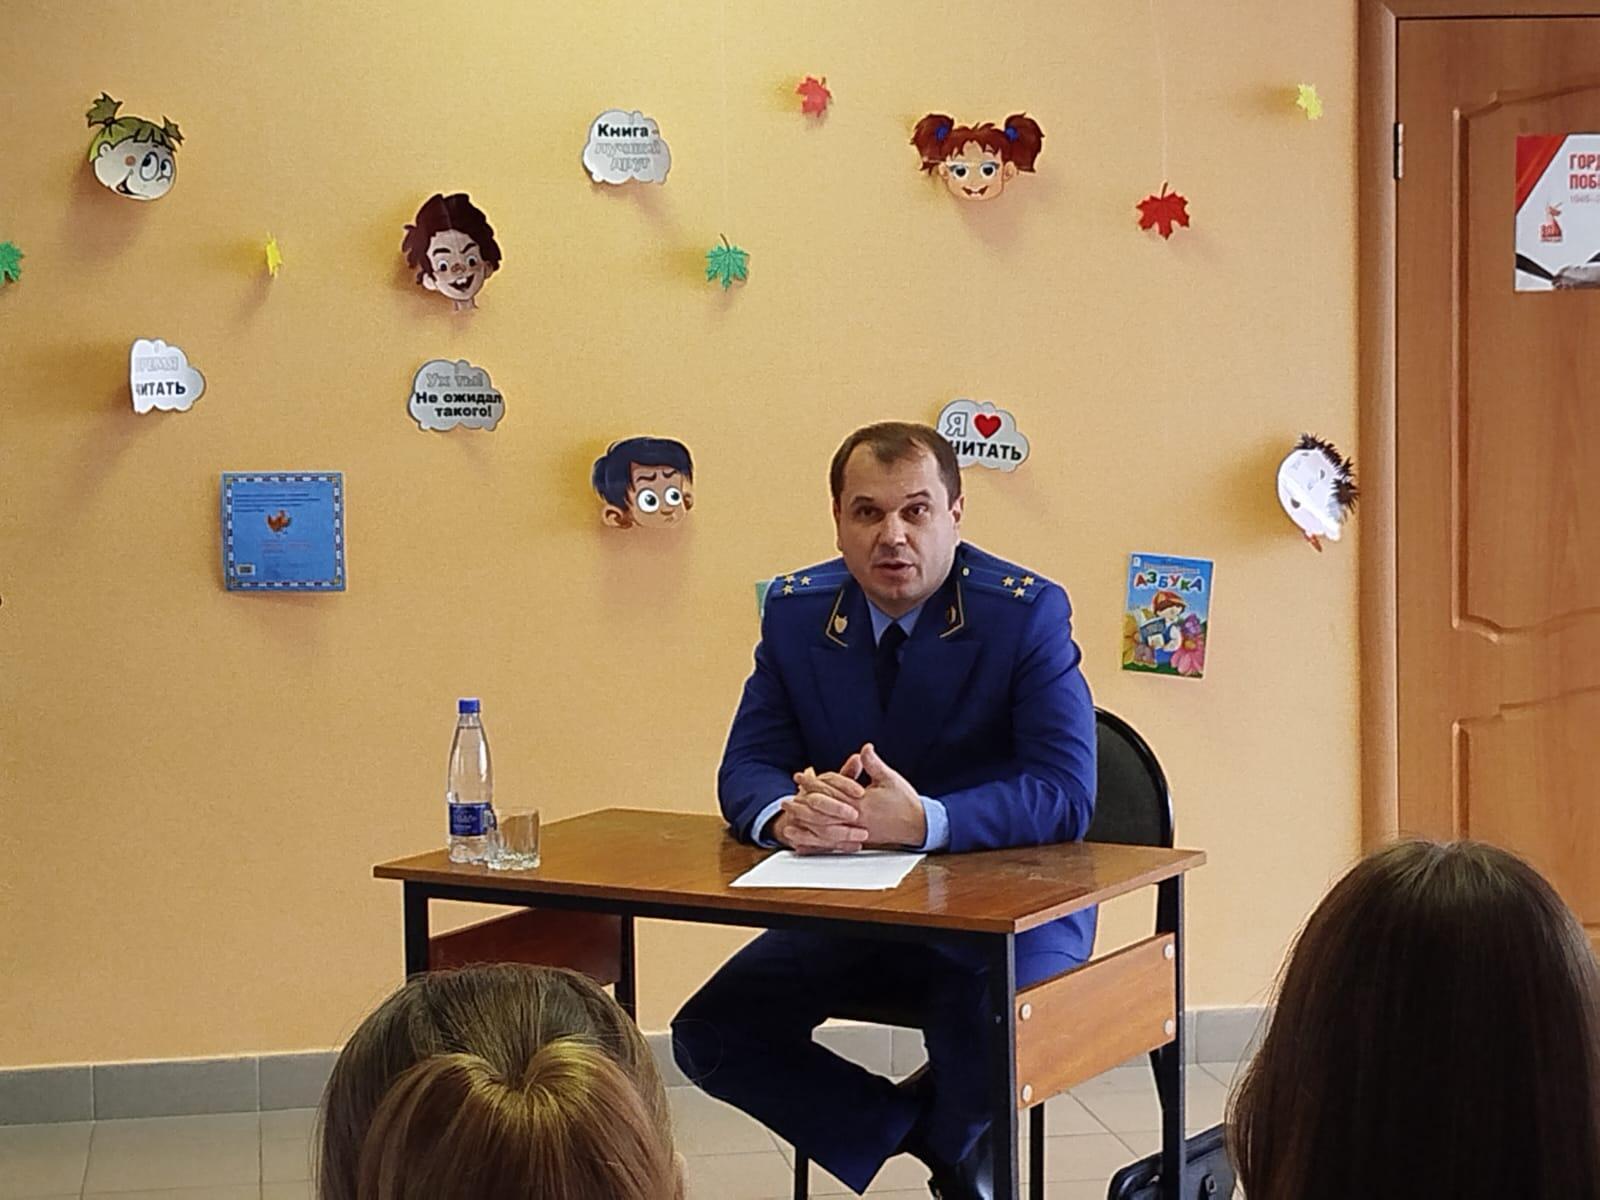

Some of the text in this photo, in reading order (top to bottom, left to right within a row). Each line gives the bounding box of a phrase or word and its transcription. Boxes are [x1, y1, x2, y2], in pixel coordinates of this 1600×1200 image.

[597, 123, 648, 137] Книга
[1569, 174, 1600, 190] ПОБ
[416, 391, 502, 405] Не ожидал
[434, 405, 492, 417] такого!
[945, 411, 968, 437] Я
[1135, 571, 1203, 593] АЗБУКА
